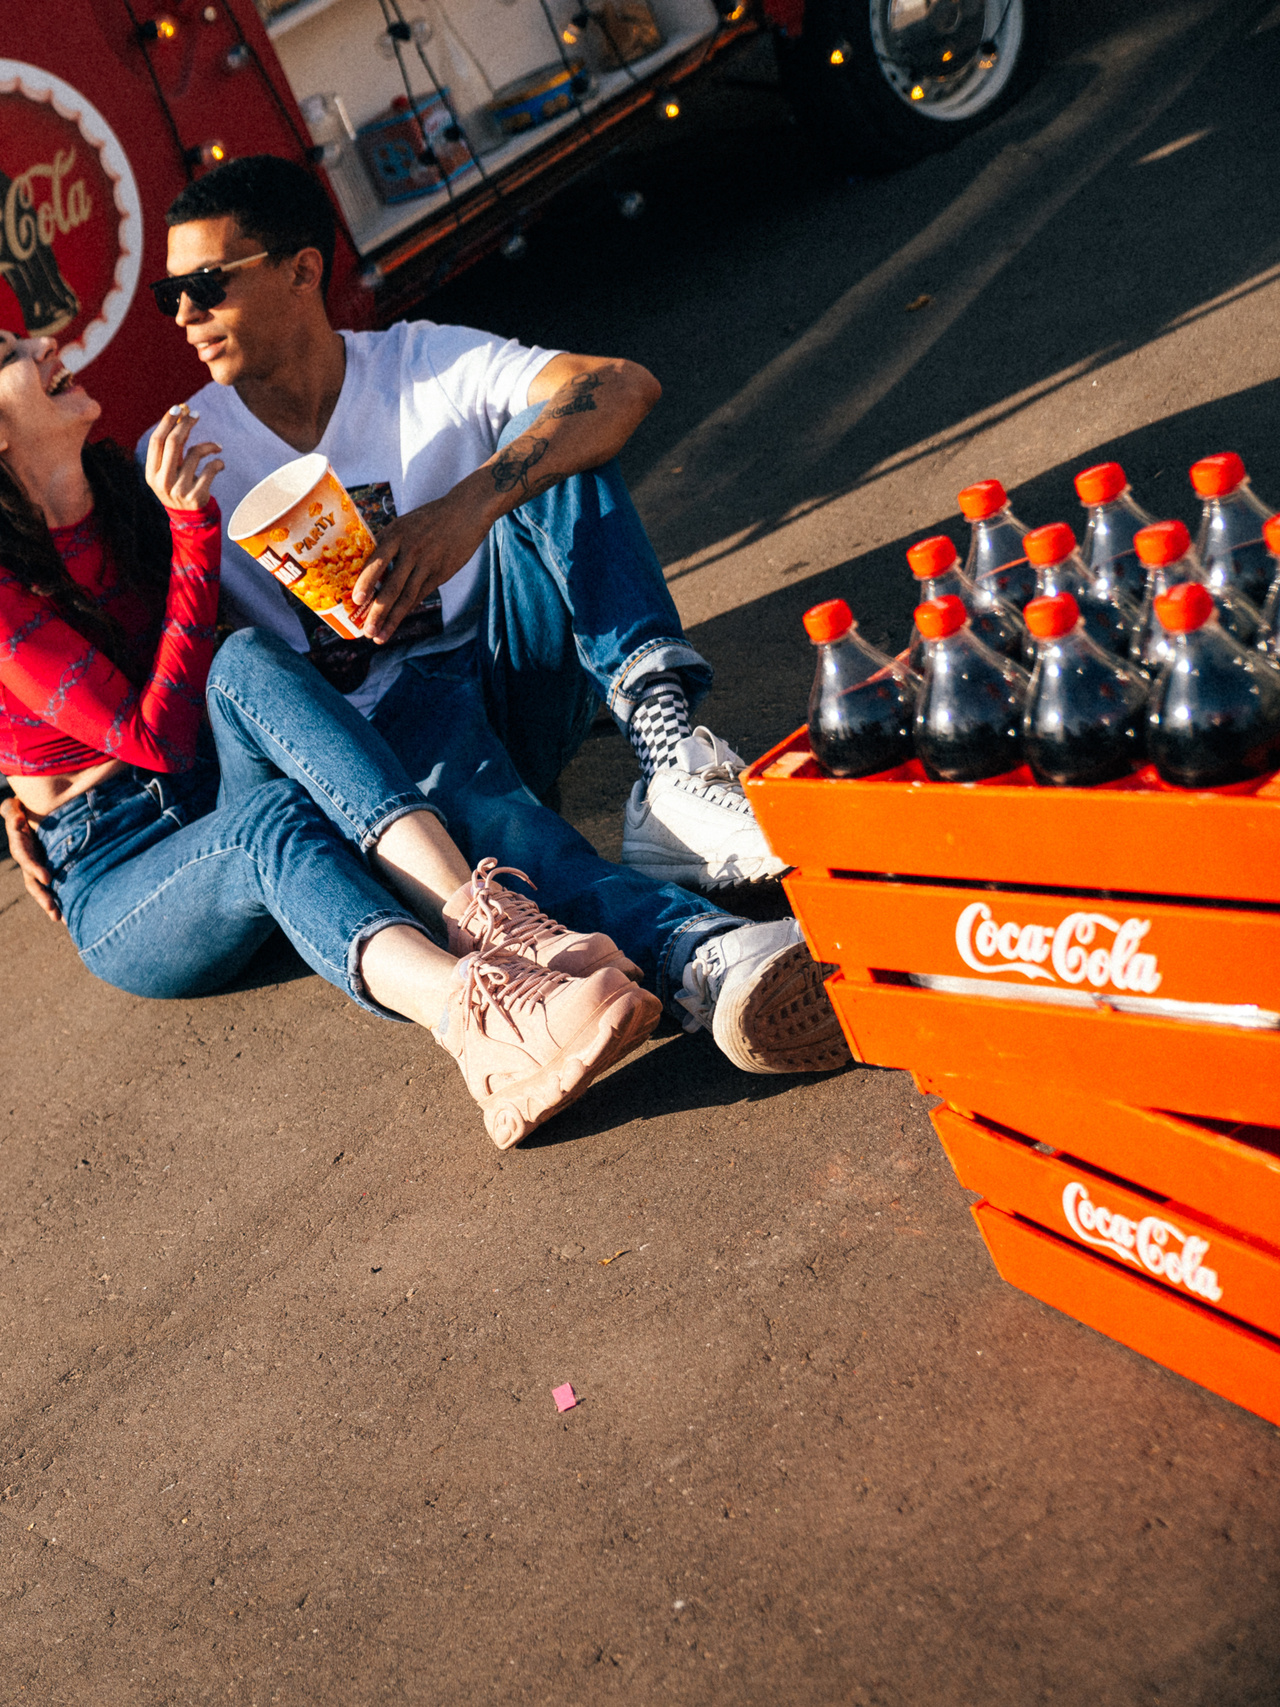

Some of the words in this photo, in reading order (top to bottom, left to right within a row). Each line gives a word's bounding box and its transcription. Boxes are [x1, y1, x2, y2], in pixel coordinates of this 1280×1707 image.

[292, 511, 336, 555] PARTY
[274, 561, 303, 586] BAR
[955, 902, 1162, 994] Coca-Cola
[1062, 1182, 1223, 1302] Coca-Cola
